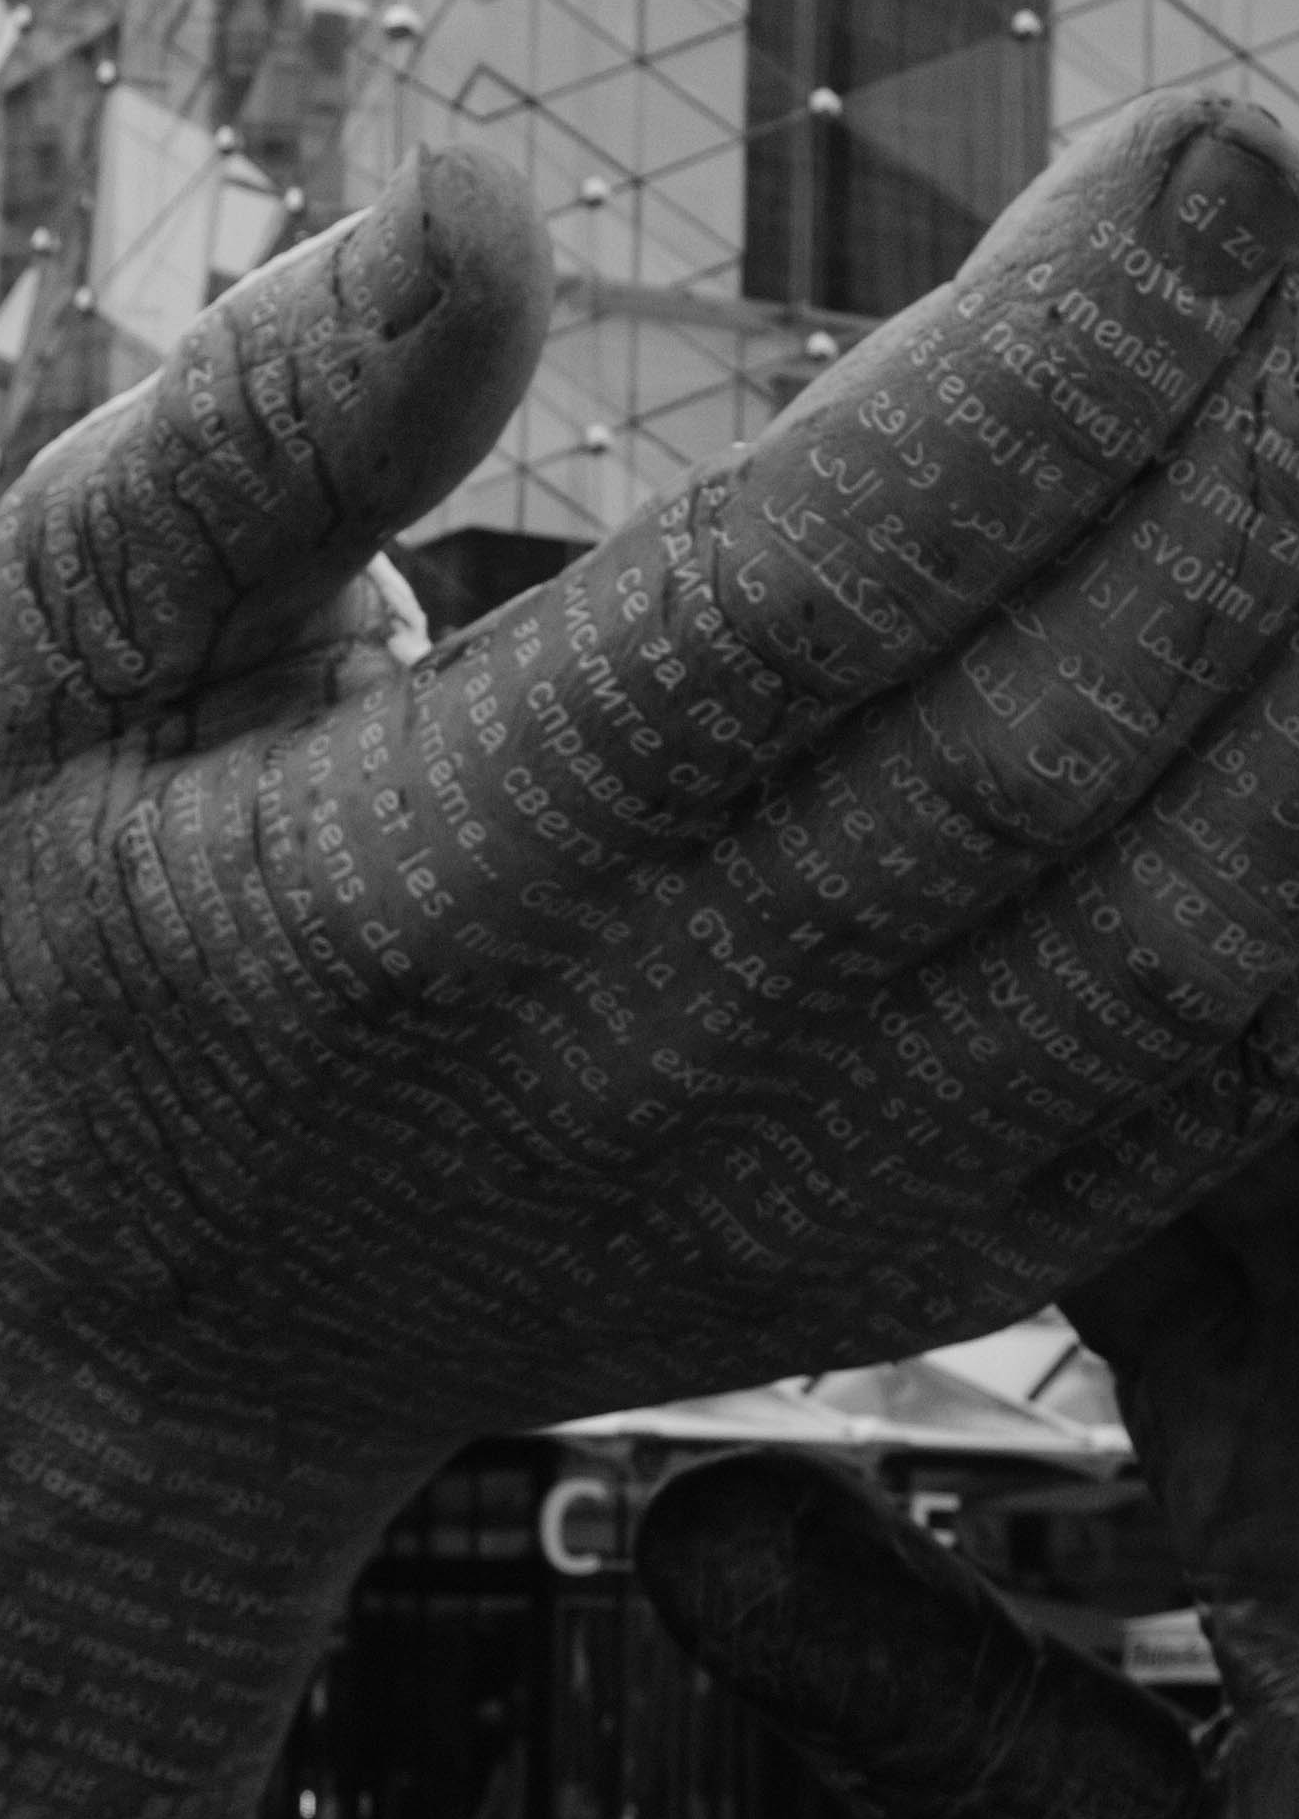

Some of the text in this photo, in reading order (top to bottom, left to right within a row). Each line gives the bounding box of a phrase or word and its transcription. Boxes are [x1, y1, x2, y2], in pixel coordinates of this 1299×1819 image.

[1178, 193, 1226, 231] si
[1089, 220, 1198, 317] stojte
[638, 635, 687, 692] за
[310, 795, 369, 905] sens
[358, 918, 415, 977] de
[371, 786, 417, 836] et
[395, 845, 456, 919] les
[634, 942, 679, 993] la
